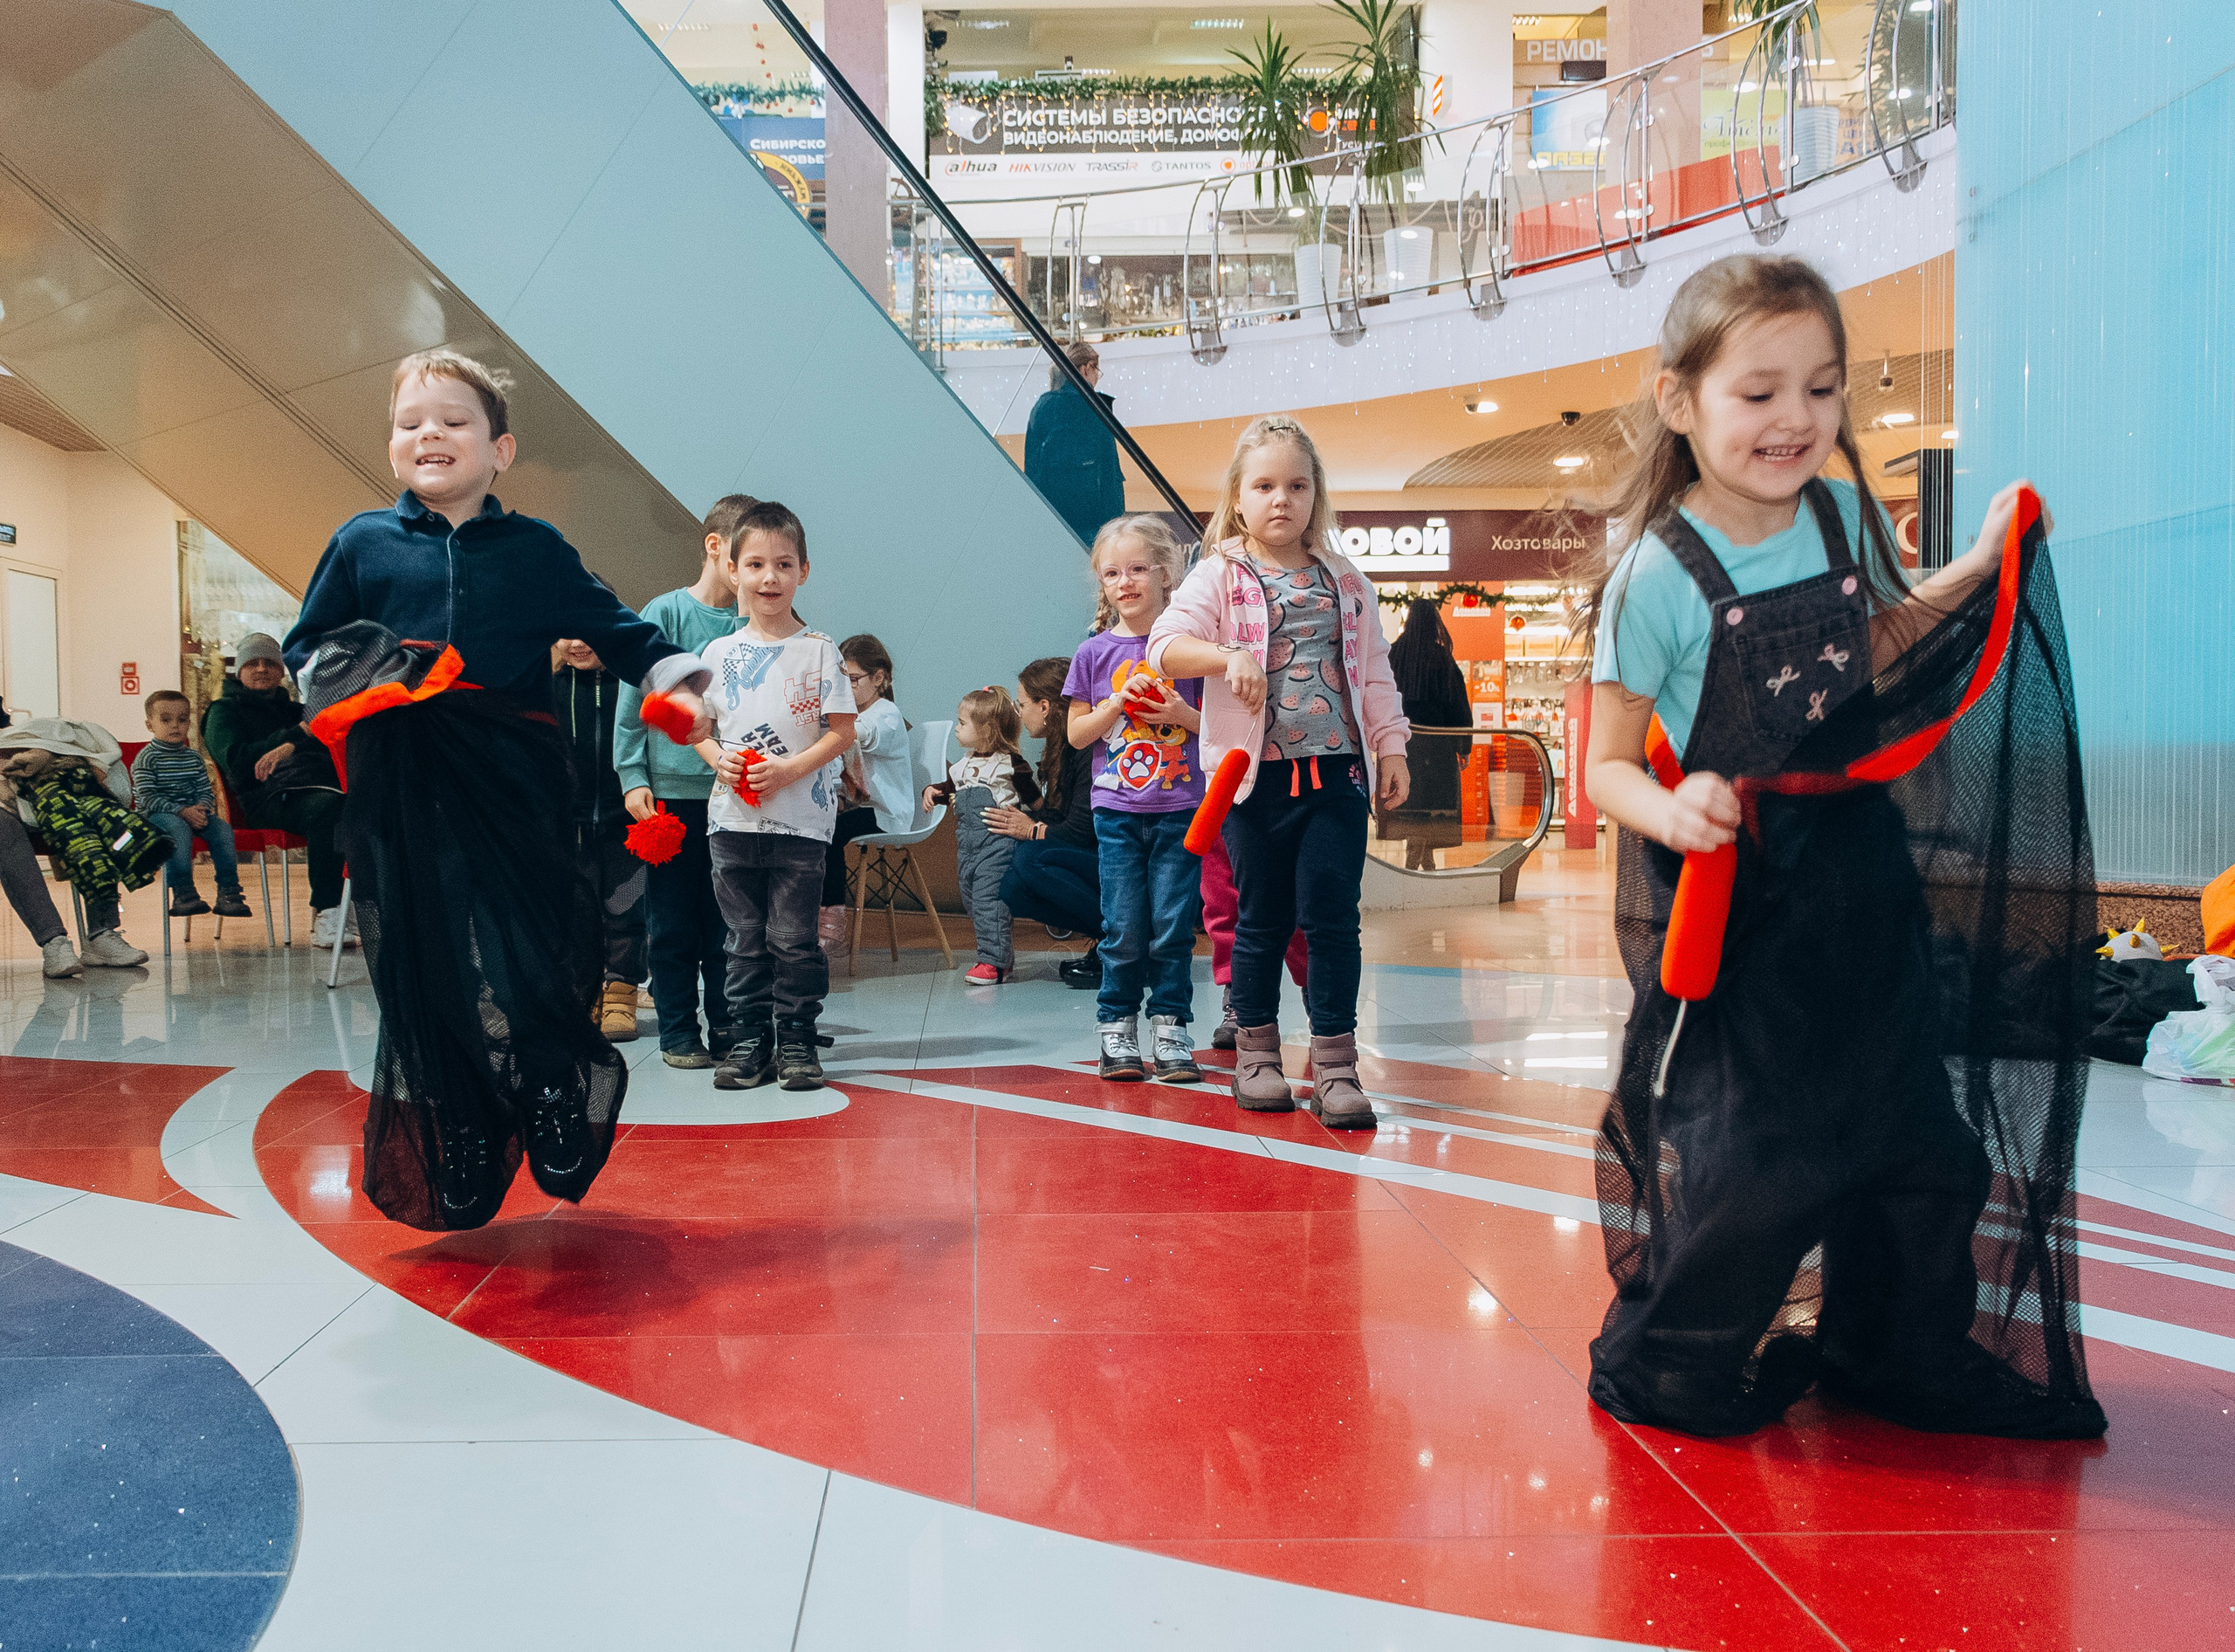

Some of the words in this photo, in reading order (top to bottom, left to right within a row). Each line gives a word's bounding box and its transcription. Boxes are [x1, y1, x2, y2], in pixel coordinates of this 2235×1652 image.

[1003, 108, 1106, 127] СИСТЕМЫ
[1004, 129, 1177, 146] ВИДЕОНАБЛЮДЕНИЕ,
[1008, 162, 1076, 173] HIKVISION
[1166, 162, 1211, 170] TANTOS
[1490, 533, 1586, 554] Хозтовары
[1474, 681, 1501, 693] -10%
